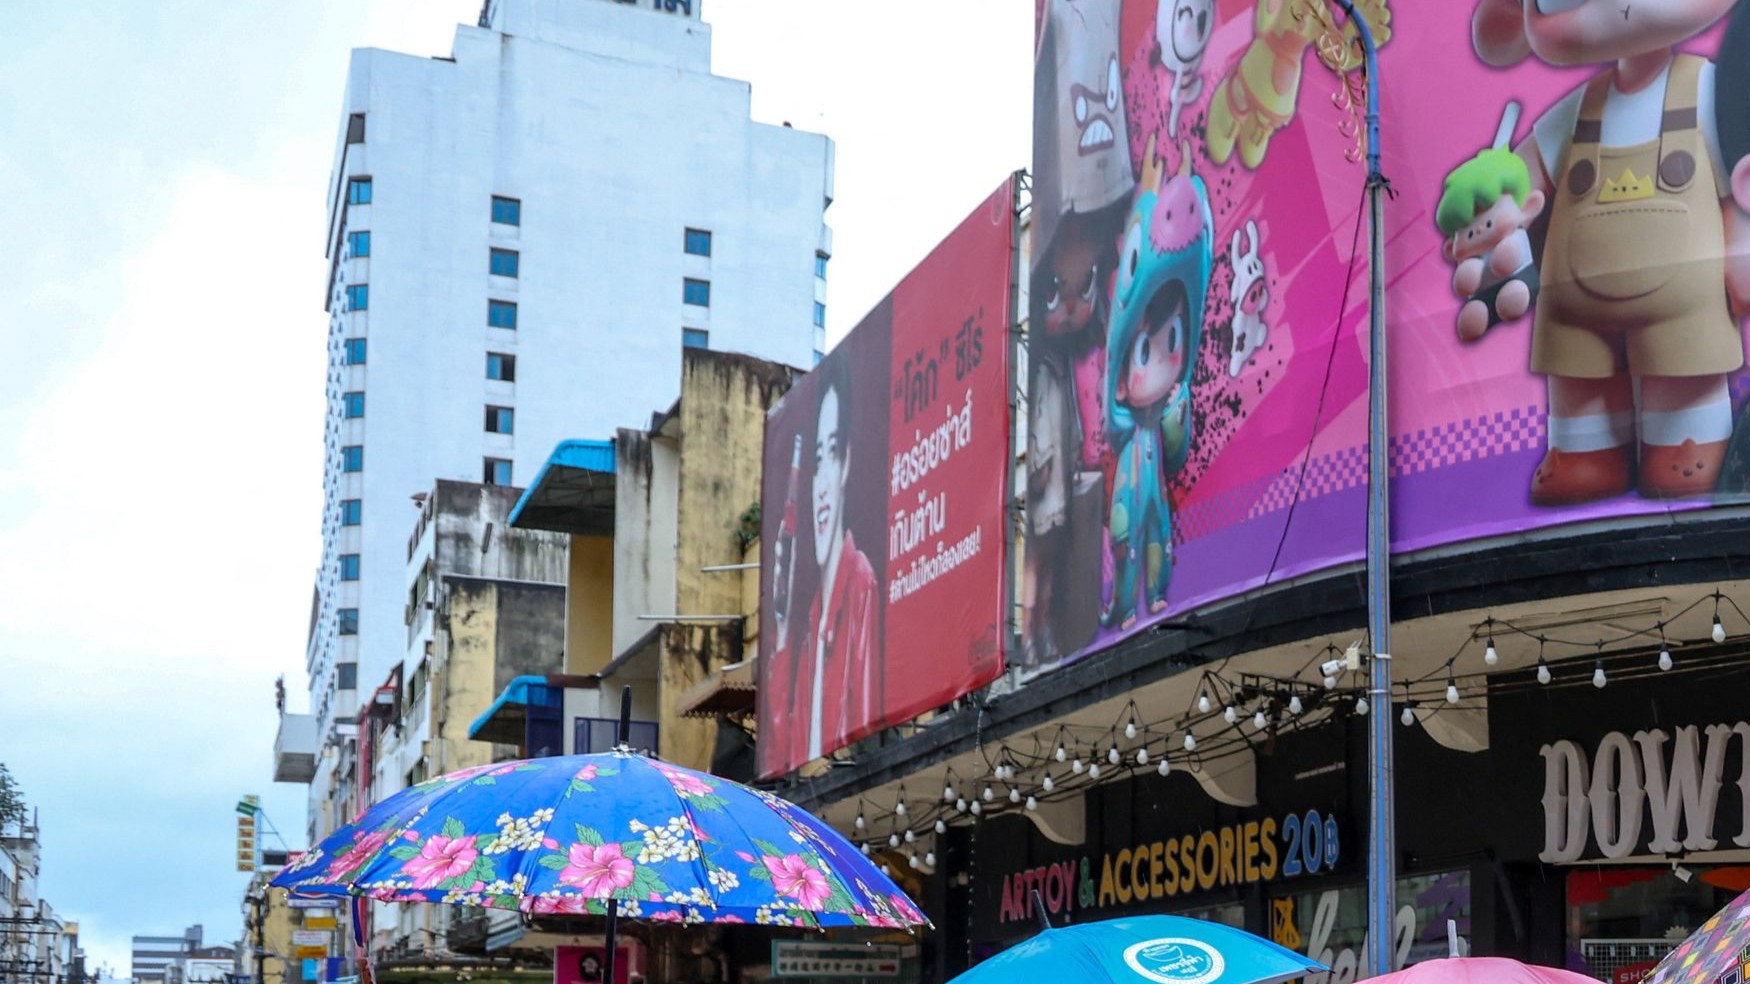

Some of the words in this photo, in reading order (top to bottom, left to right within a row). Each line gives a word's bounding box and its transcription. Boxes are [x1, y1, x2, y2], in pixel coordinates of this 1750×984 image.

[890, 388, 973, 496] #อร่อยซ่าส์
[889, 490, 947, 561] เกินต้าน
[1078, 856, 1096, 908] &
[1098, 817, 1278, 908] ACCESSORIES
